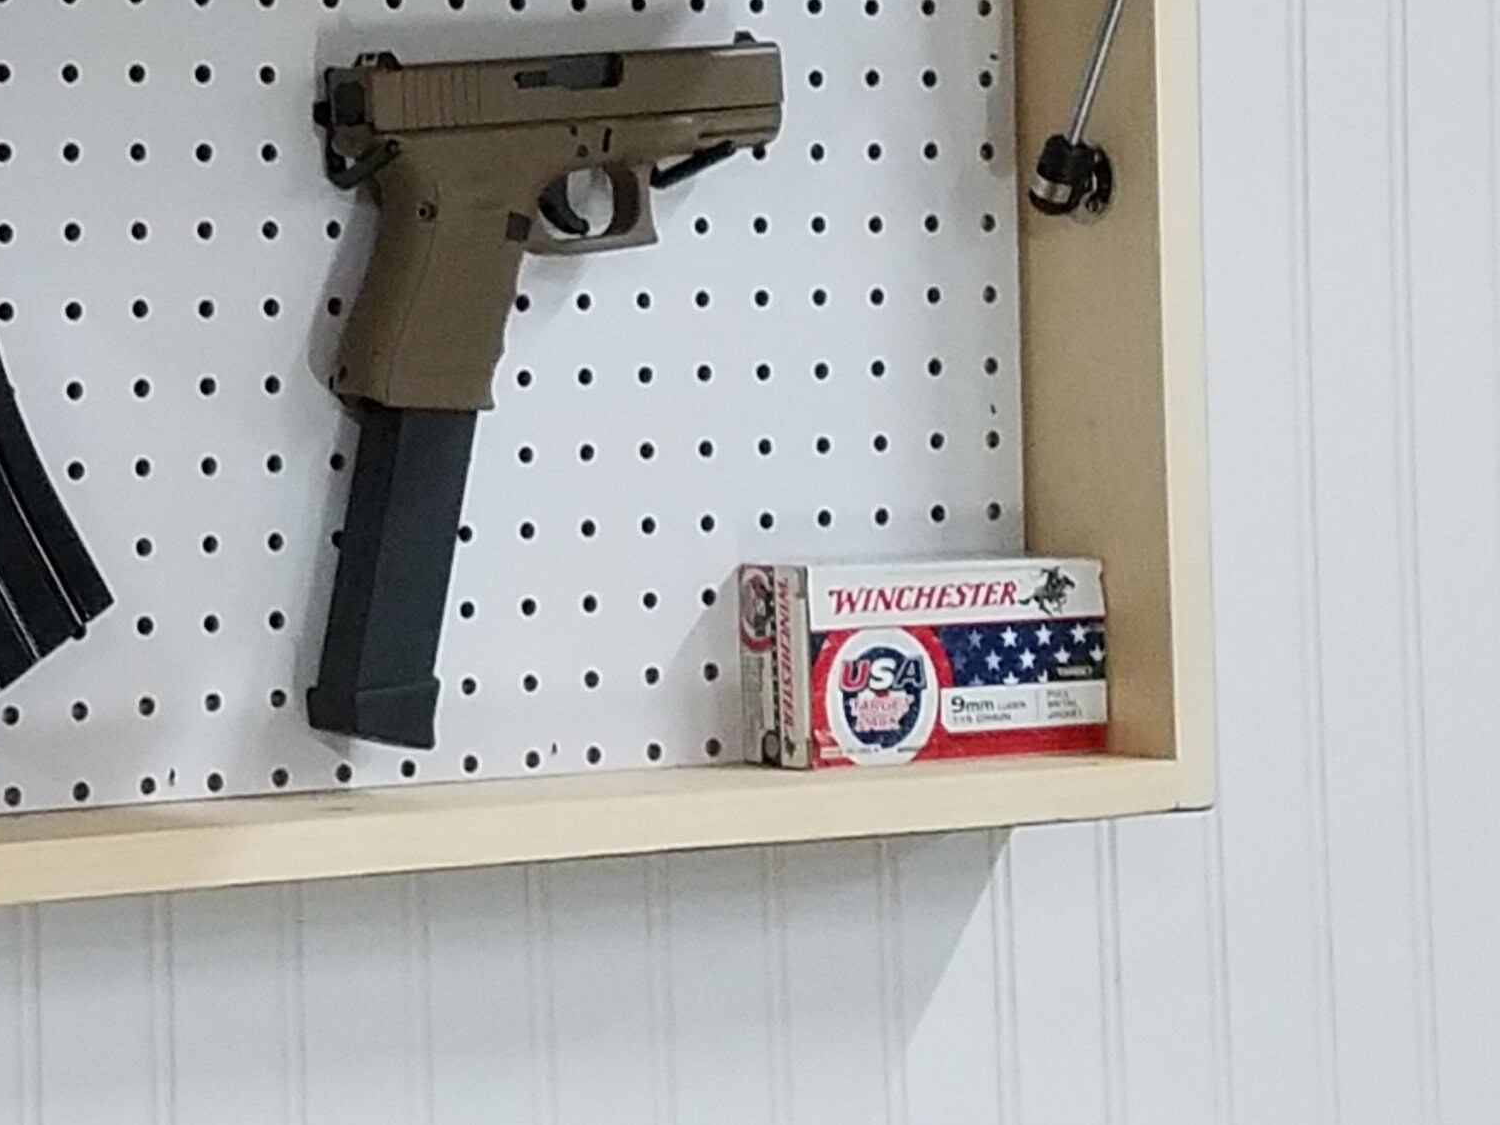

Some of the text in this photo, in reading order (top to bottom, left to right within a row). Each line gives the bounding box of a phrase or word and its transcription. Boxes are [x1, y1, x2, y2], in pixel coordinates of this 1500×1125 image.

[828, 581, 1018, 615] WINCHESTER
[778, 578, 794, 726] WINCHESTER
[840, 656, 927, 693] USA
[950, 695, 995, 713] 9mm
